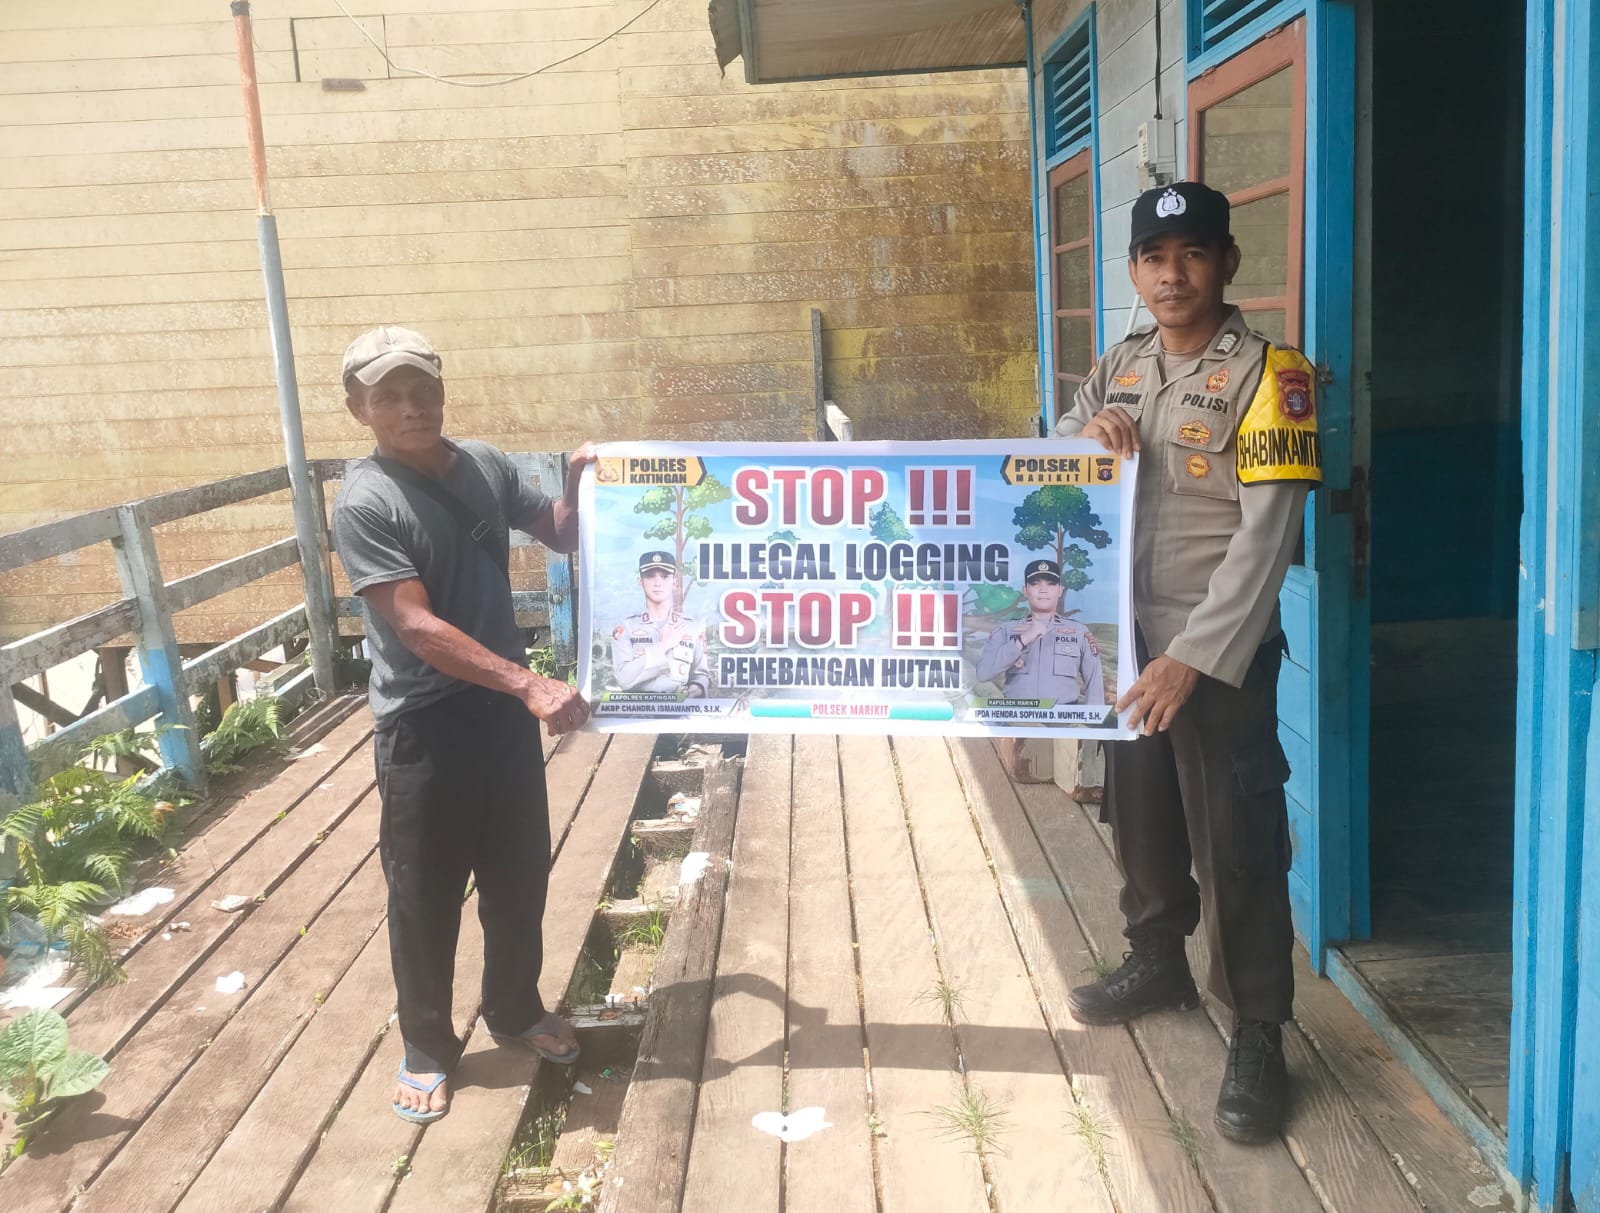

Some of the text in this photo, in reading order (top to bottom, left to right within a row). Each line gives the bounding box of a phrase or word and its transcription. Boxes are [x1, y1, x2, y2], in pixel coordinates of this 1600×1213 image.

[1181, 393, 1229, 414] POLISI
[629, 458, 687, 473] POLRES
[1014, 458, 1081, 473] POLSEK
[629, 473, 687, 484] KATINGAN
[1015, 473, 1080, 483] MARIKIT
[735, 468, 972, 526] STOP !!!
[699, 542, 1010, 583] ILLEGAL LOGGING
[723, 591, 959, 647] STOP !!!
[1055, 636, 1078, 644] POLRI
[720, 656, 961, 689] PENEBANGAN HUTAN
[600, 705, 620, 713] AKBP
[621, 705, 656, 713] CHANDRA
[657, 705, 703, 714] ISMAWANTO,
[812, 703, 889, 717] POLSEK MARIKIT
[975, 710, 990, 718] IPDA
[991, 710, 1018, 719] HENDRA
[1019, 710, 1047, 719] SOPIYAN
[1049, 711, 1056, 719] D.
